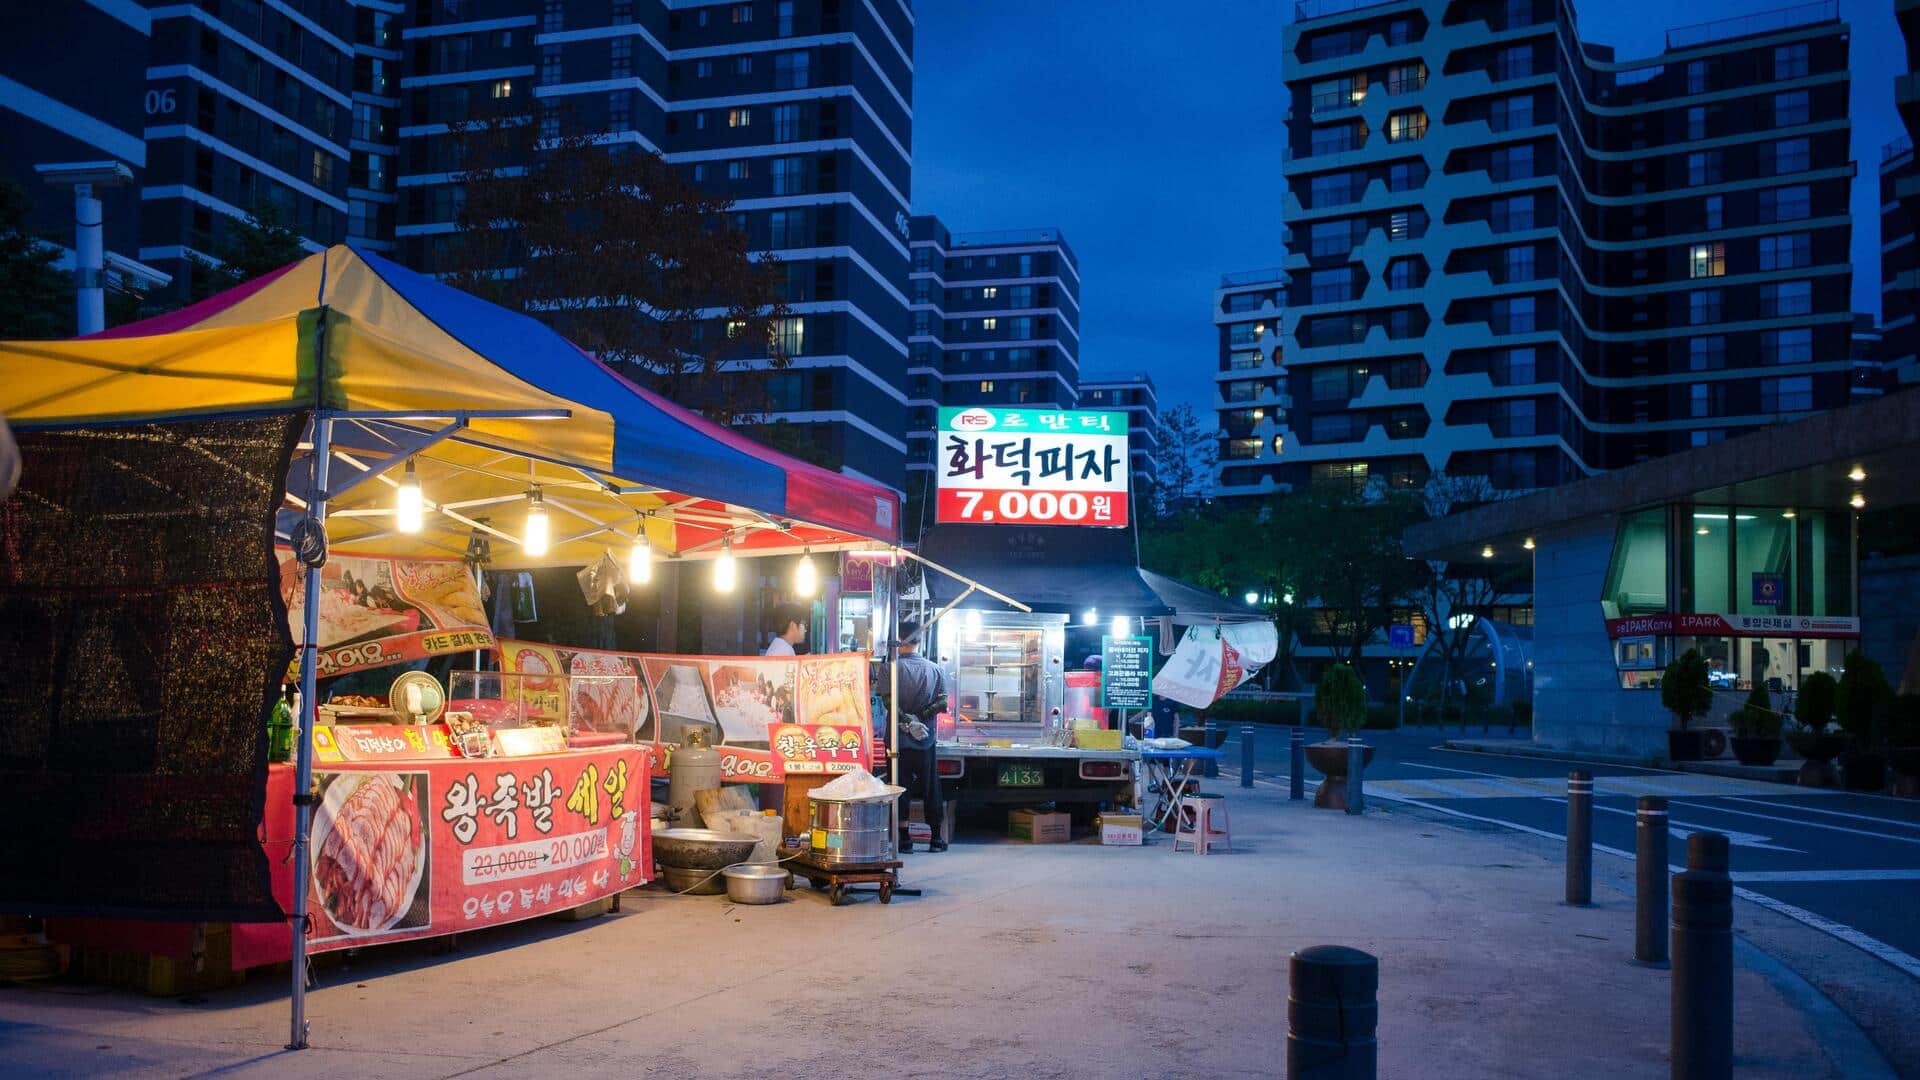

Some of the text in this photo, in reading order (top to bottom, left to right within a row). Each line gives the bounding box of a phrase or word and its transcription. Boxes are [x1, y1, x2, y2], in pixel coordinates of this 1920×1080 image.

[961, 415, 988, 425] RS
[946, 435, 1121, 486] 화덕피자
[955, 491, 1112, 521] 7,000원
[1681, 617, 1721, 628] IPARK
[424, 637, 449, 650] 카드
[449, 633, 473, 647] 결제
[316, 642, 402, 675] 있어요...
[720, 755, 781, 779] 있어요...
[1000, 771, 1041, 785] 4133
[441, 767, 562, 845] 왕족발
[566, 758, 628, 825] 세일
[473, 834, 606, 877] 23,000원 20,000원
